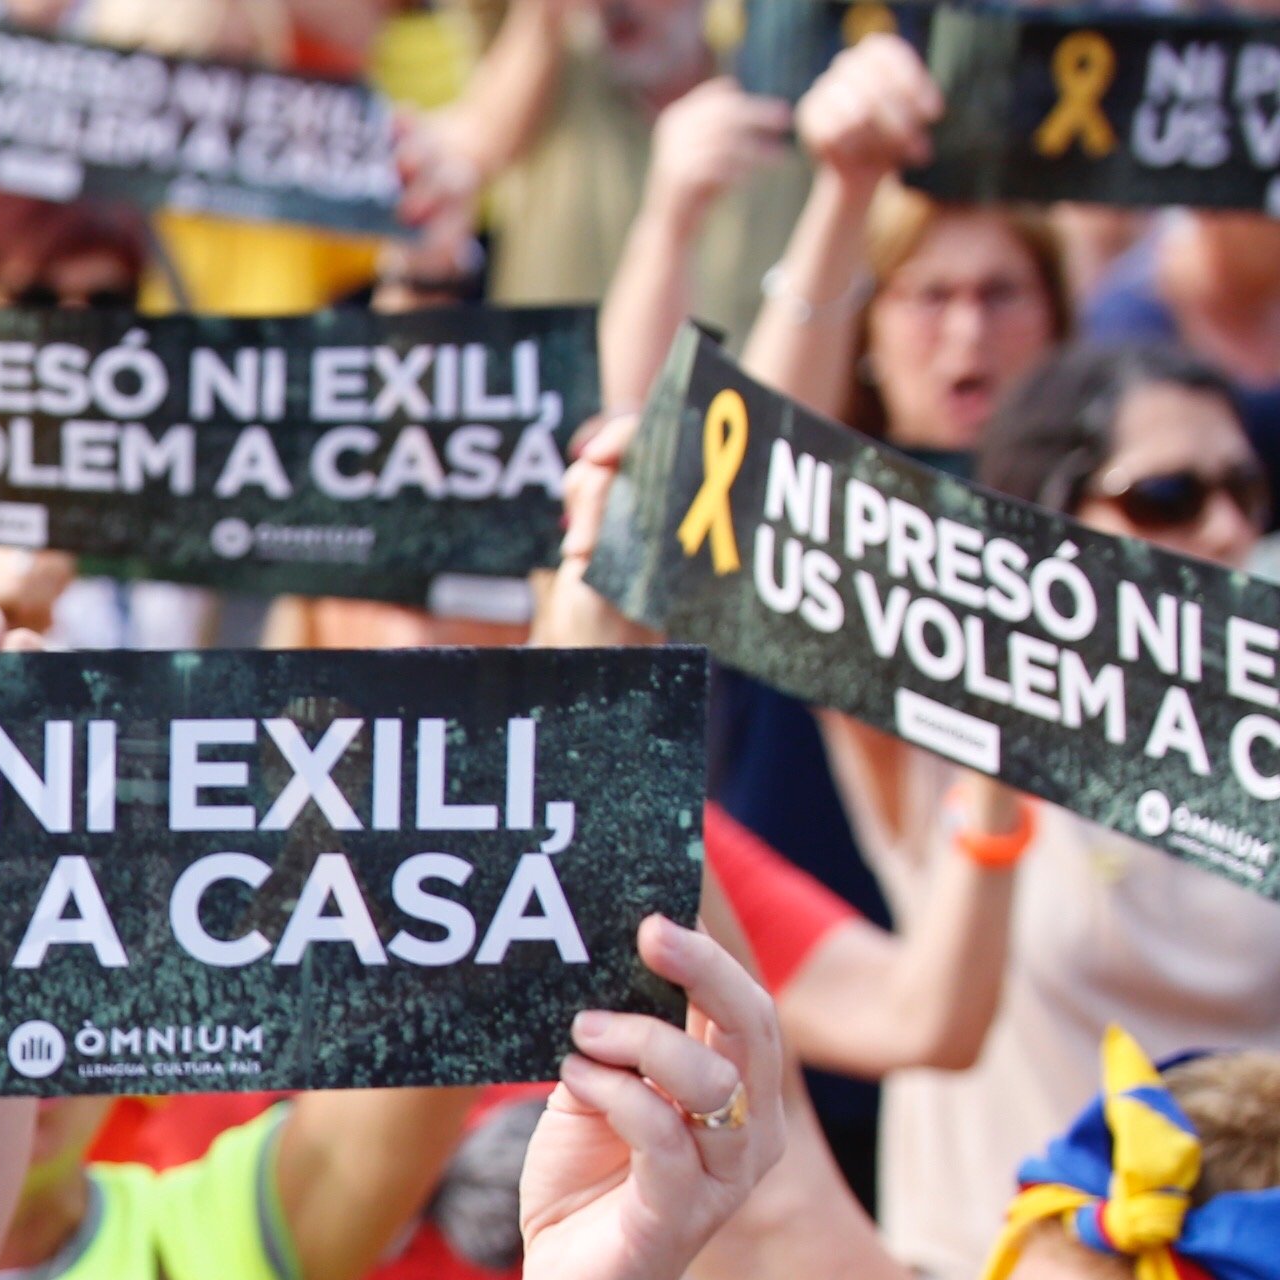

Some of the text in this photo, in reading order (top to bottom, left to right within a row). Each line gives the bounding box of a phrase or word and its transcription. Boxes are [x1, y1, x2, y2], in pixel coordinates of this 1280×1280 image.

[189, 346, 287, 422] NI
[310, 339, 563, 429] EXILI,
[215, 424, 292, 499] A
[310, 422, 566, 500] CASA
[764, 437, 832, 545] NI
[845, 477, 1098, 641] PRESÓ
[1117, 580, 1202, 683] NI
[754, 523, 845, 633] US
[854, 570, 1127, 745] VOLEM
[1144, 685, 1211, 776] A
[169, 717, 576, 854] EXILI,
[11, 854, 129, 970] A
[169, 851, 590, 967] CASA
[74, 1020, 264, 1057] ÒMNIUM
[78, 1061, 147, 1078] LLENGUA
[152, 1060, 224, 1077] CULTURA
